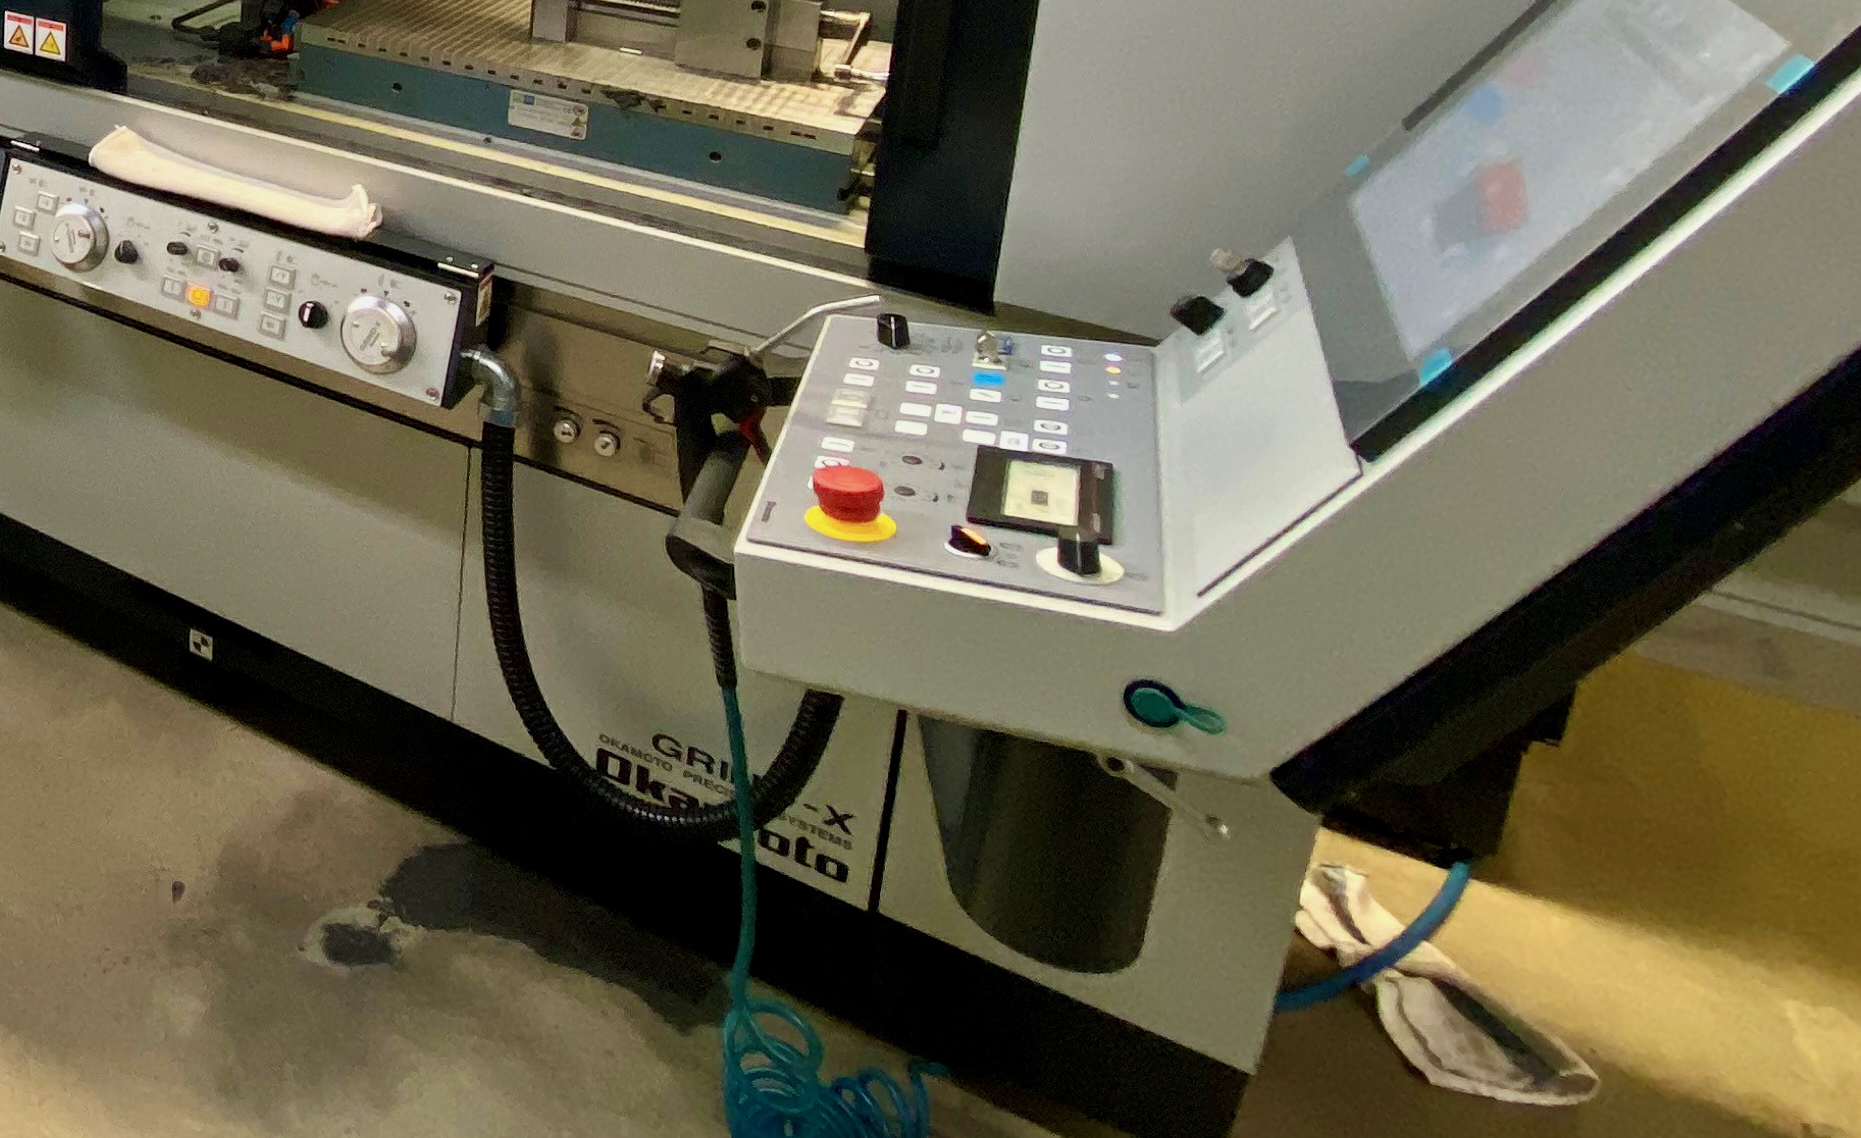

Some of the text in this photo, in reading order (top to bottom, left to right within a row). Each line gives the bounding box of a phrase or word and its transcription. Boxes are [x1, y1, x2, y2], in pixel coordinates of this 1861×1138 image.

[598, 733, 673, 772] OKAMOTO
[651, 732, 856, 837] GRI-X
[596, 747, 850, 883] Okaoto
